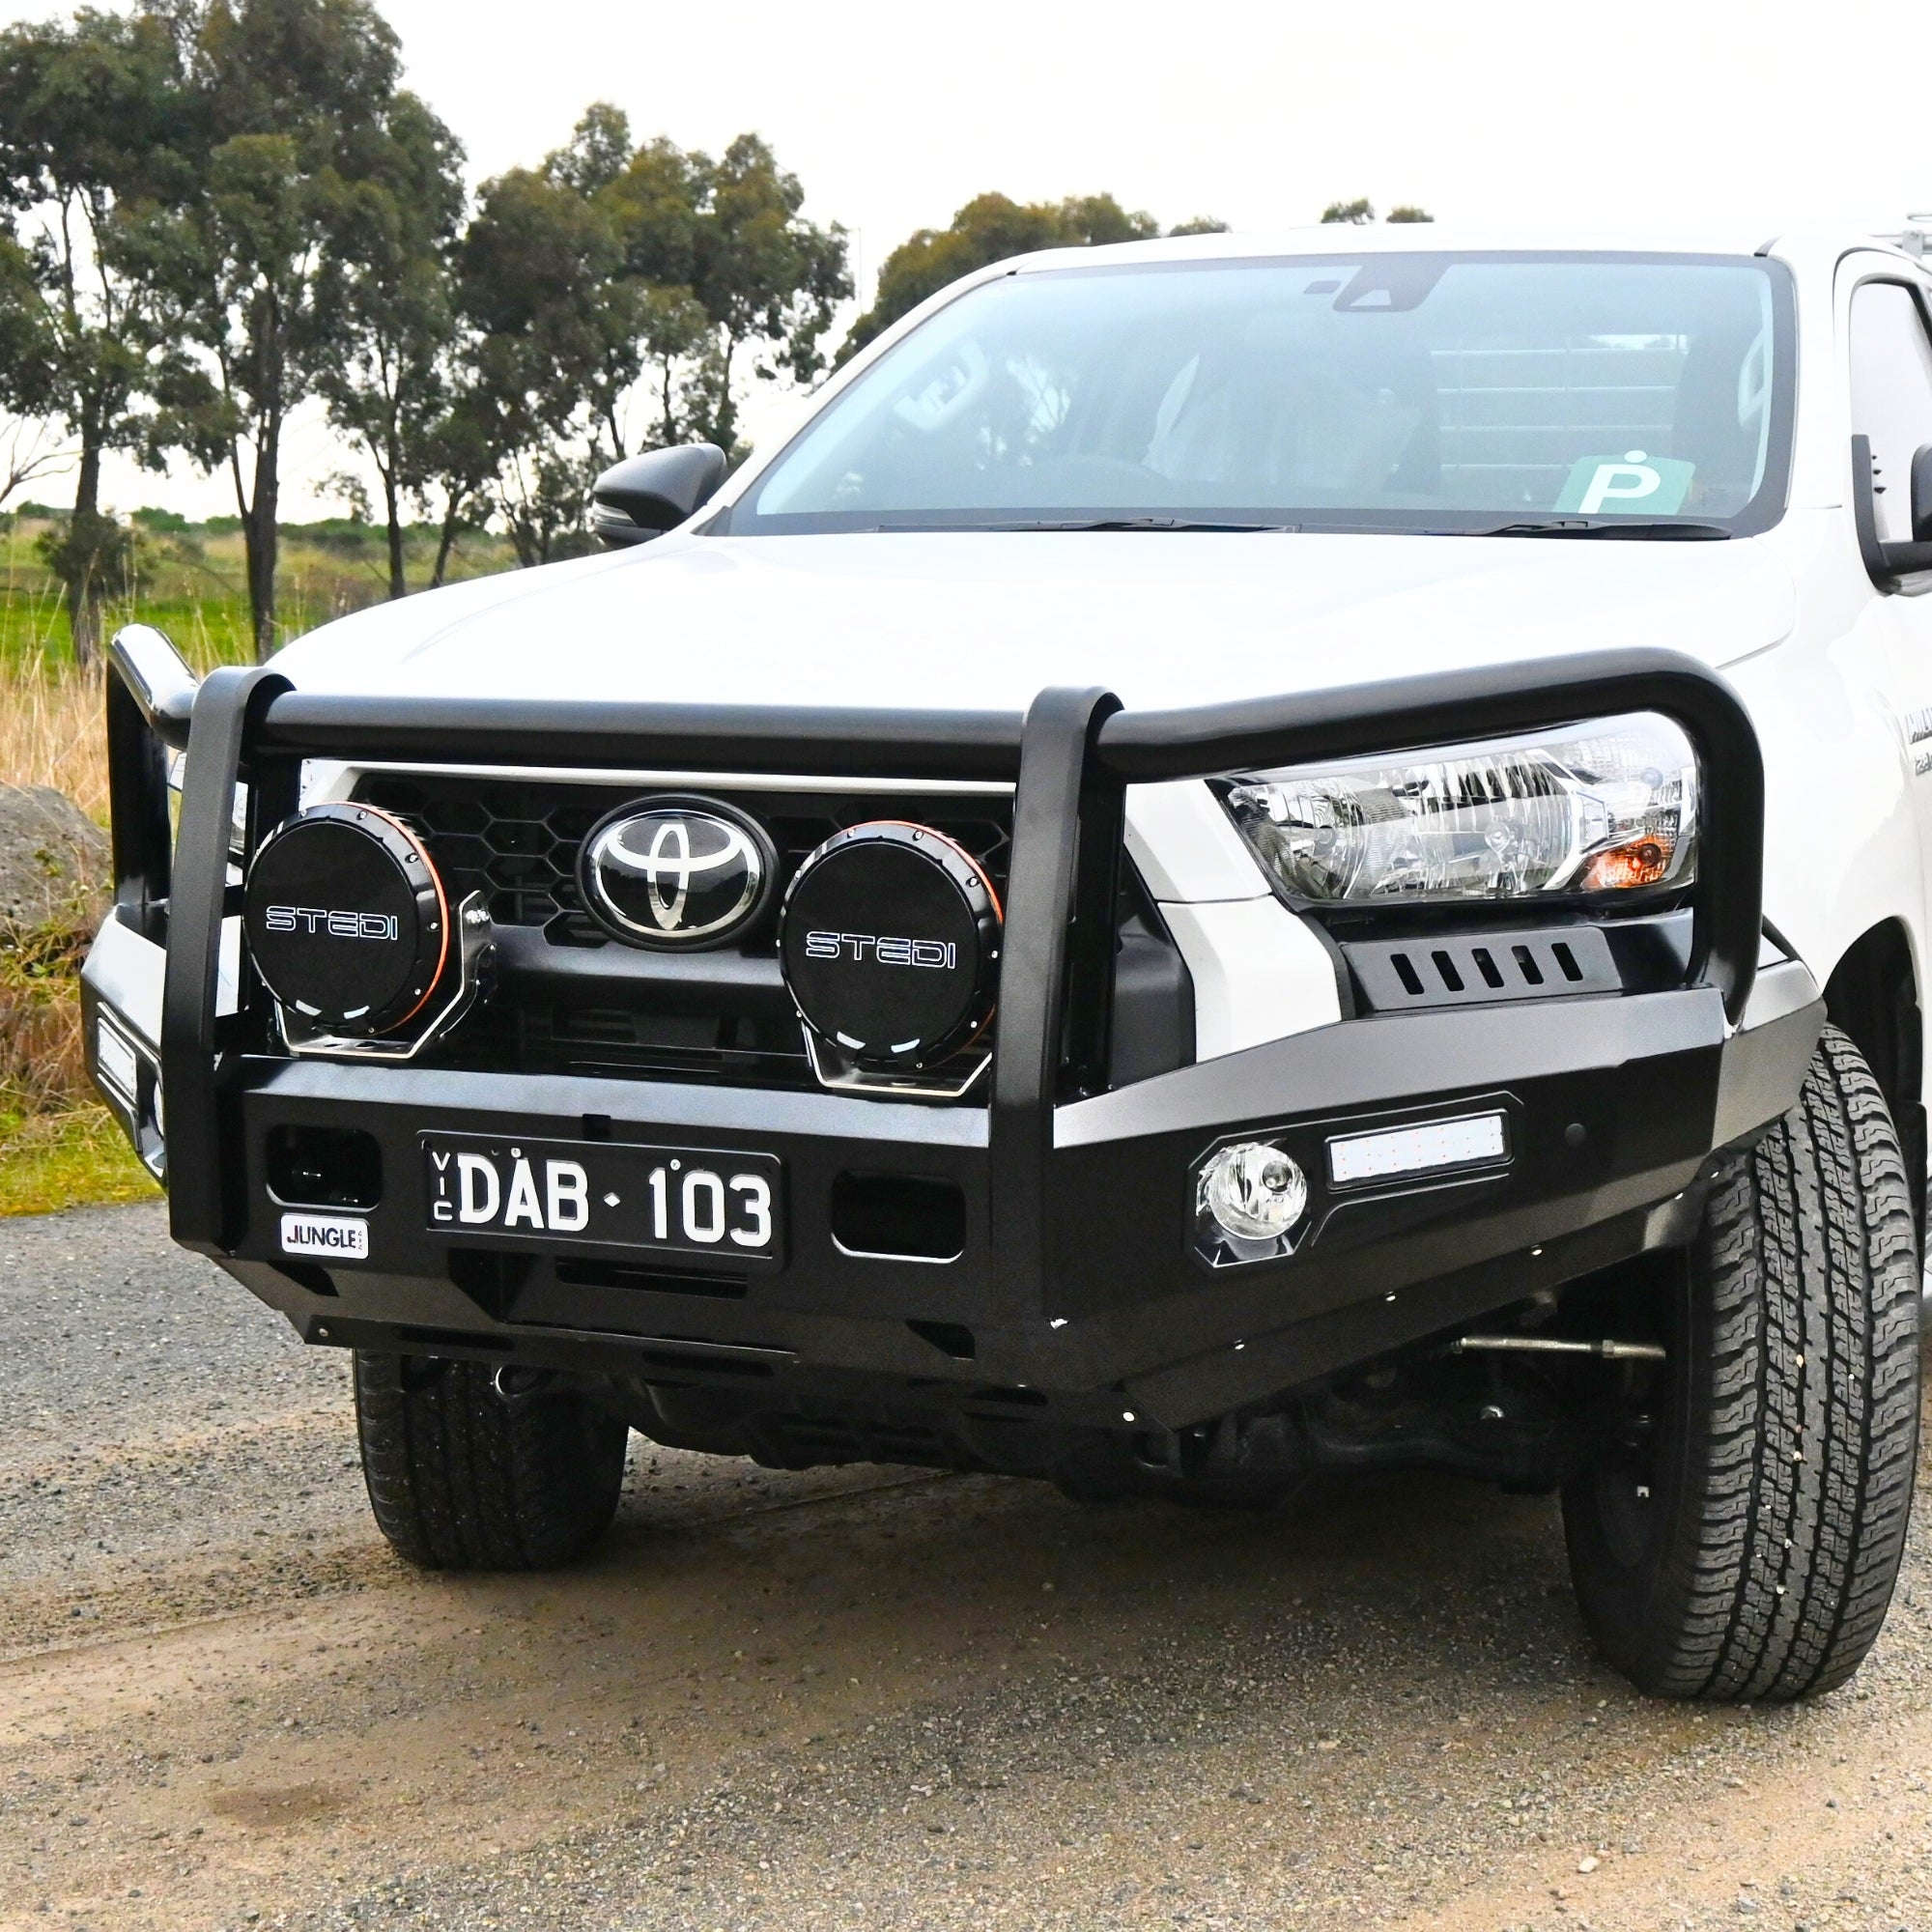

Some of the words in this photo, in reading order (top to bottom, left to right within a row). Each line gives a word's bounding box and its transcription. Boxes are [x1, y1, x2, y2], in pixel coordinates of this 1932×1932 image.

[266, 905, 398, 941] STEDI
[806, 930, 956, 970] STEDI
[432, 1151, 453, 1221] VIC
[457, 1152, 589, 1232] DAB
[648, 1167, 772, 1248] 103
[287, 1224, 356, 1249] JUNGLE
